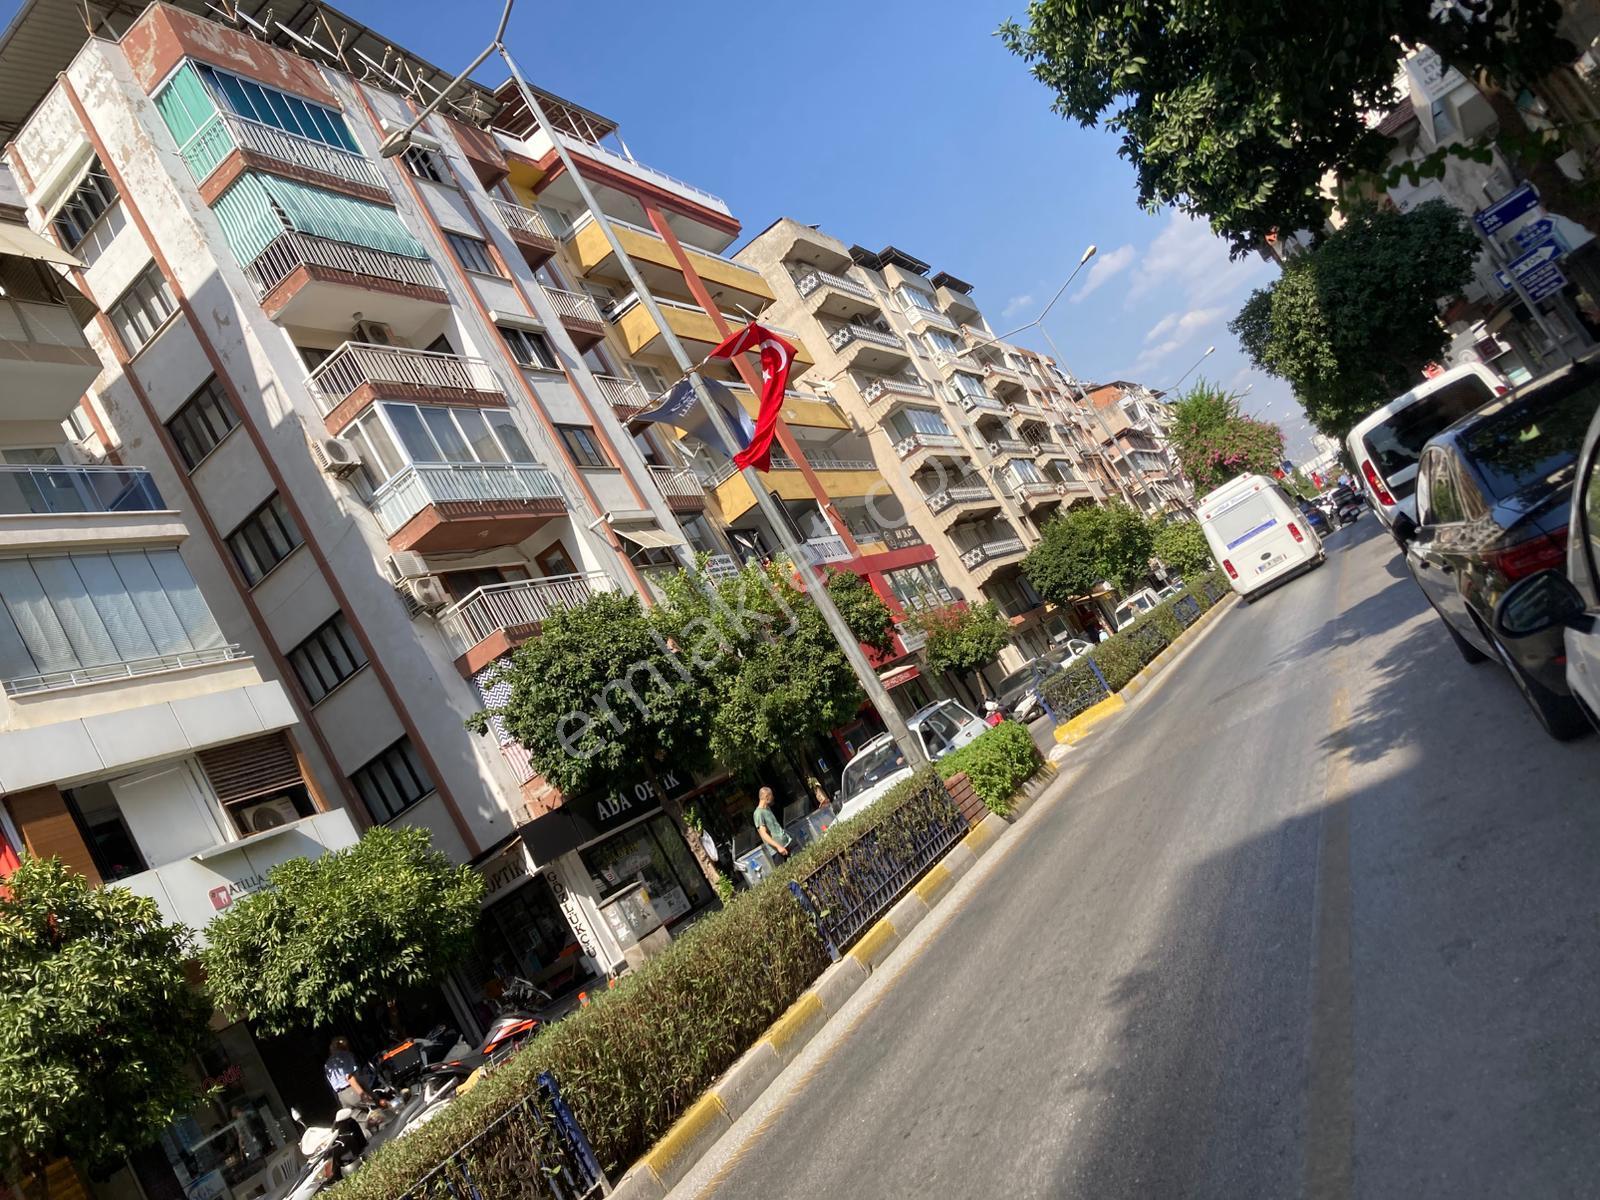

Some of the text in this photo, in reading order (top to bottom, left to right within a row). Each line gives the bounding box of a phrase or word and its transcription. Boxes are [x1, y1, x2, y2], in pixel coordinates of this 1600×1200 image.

[597, 769, 681, 821] ADA OPIK
[546, 871, 597, 958] GÖZLÜKÇÜ
